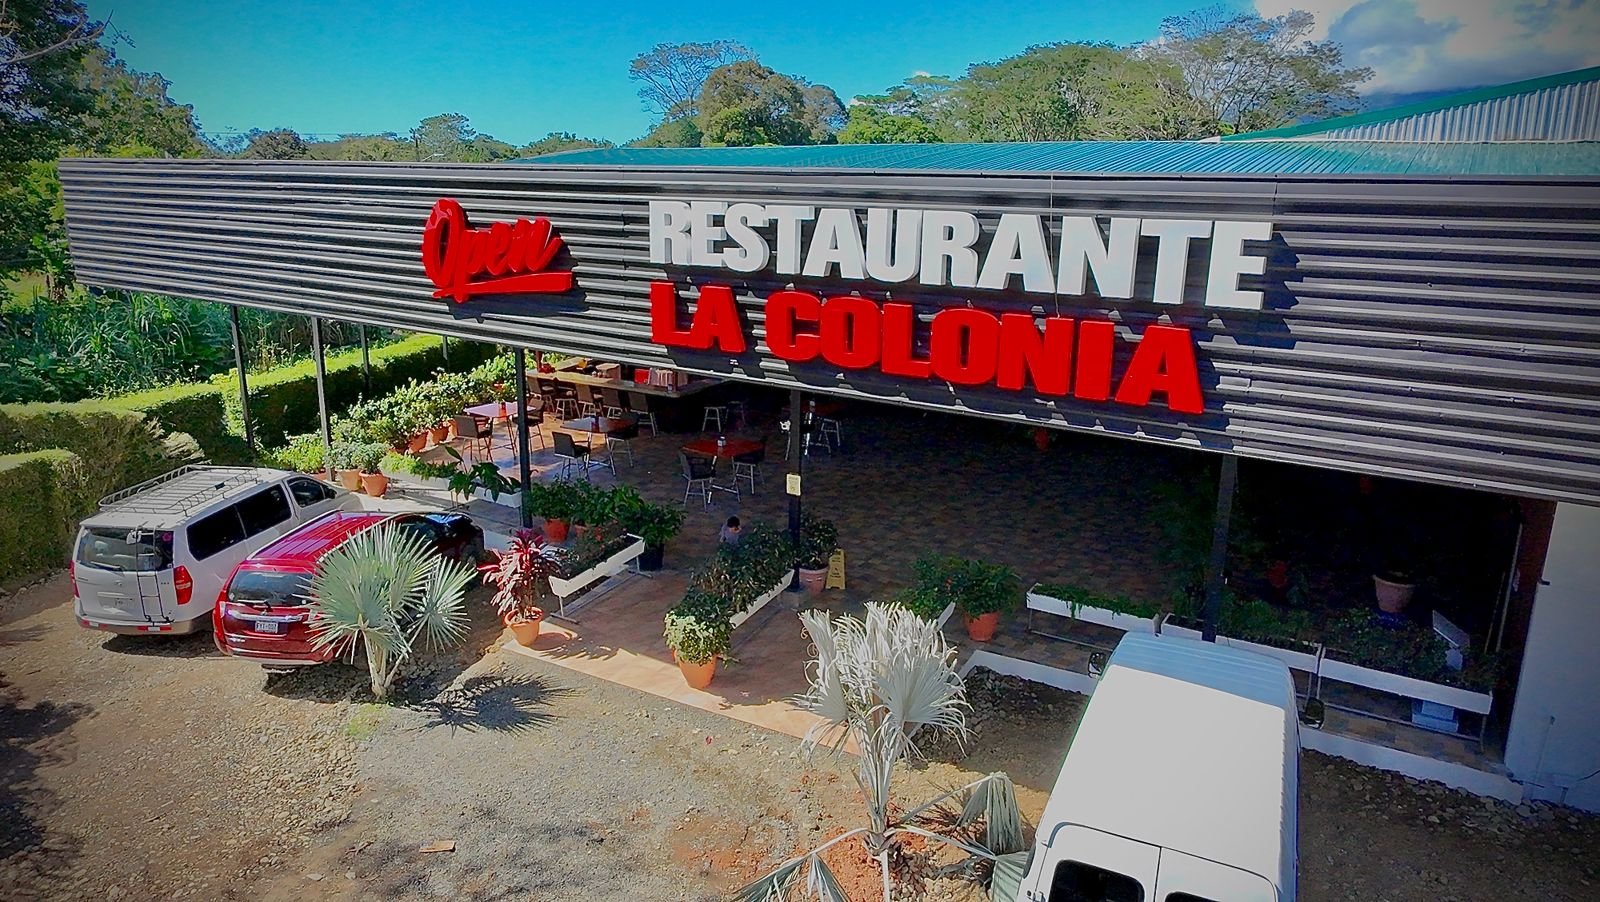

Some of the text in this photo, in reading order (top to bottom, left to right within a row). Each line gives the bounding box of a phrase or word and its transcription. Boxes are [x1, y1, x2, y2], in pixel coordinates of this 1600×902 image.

[421, 199, 568, 303] Open
[649, 200, 1272, 311] RESTAURANTE
[649, 282, 1206, 415] LA COLONIA
